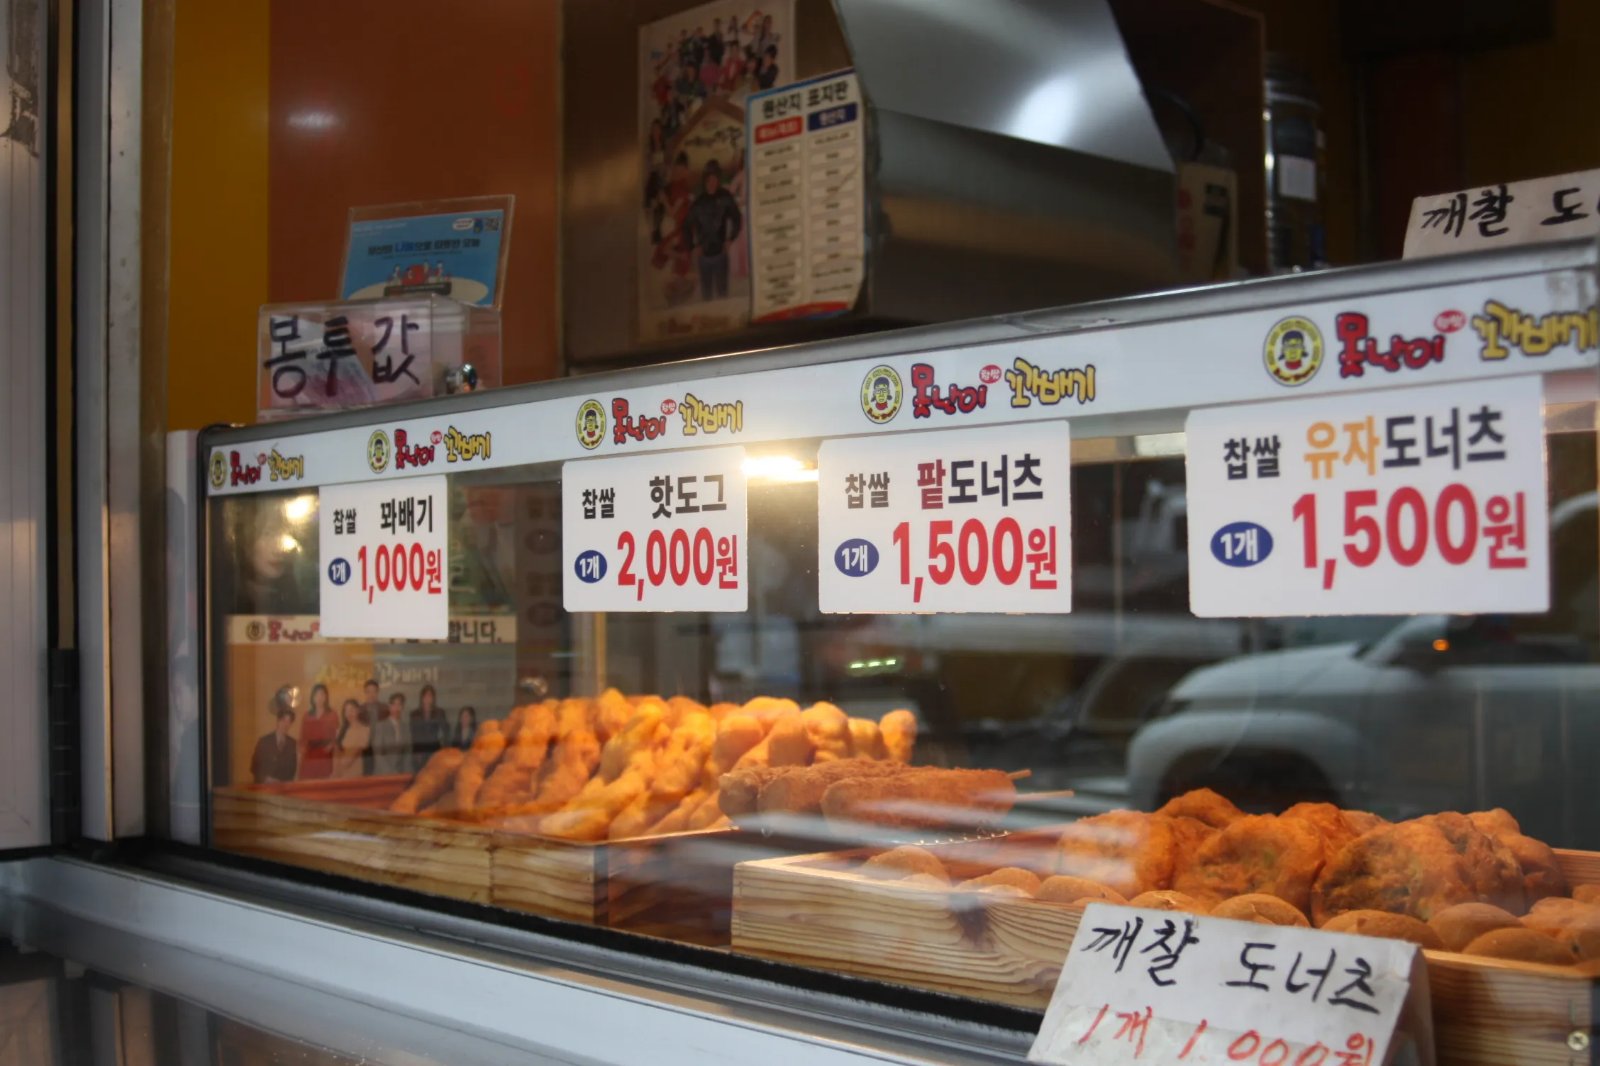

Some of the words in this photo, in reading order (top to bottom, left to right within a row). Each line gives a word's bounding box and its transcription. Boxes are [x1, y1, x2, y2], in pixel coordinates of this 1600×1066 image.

[1421, 184, 1514, 238] 깨찰
[1540, 187, 1600, 226] 도
[910, 363, 988, 419] 못난이
[1224, 434, 1281, 480] 찹쌀
[1304, 406, 1506, 480] 유자도너츠
[582, 487, 615, 519] 찹쌀
[649, 474, 727, 519] 핫도그
[845, 472, 890, 509] 찹쌀
[917, 453, 1043, 510] 팥도너츠
[333, 509, 357, 535] 찹쌀
[380, 495, 433, 535] 꽈배기
[1220, 528, 1259, 562] 1개
[1293, 483, 1527, 590] 1,500원
[330, 562, 347, 584] 1개
[358, 542, 442, 603] 1,000원
[578, 555, 601, 580] 1개
[617, 527, 738, 601] 2,000원
[841, 545, 869, 572] 1개
[893, 517, 1057, 603] 1,500원
[1080, 914, 1199, 986] 깨찰
[1225, 942, 1380, 1014] 도너츠
[1079, 1004, 1153, 1060] 1개
